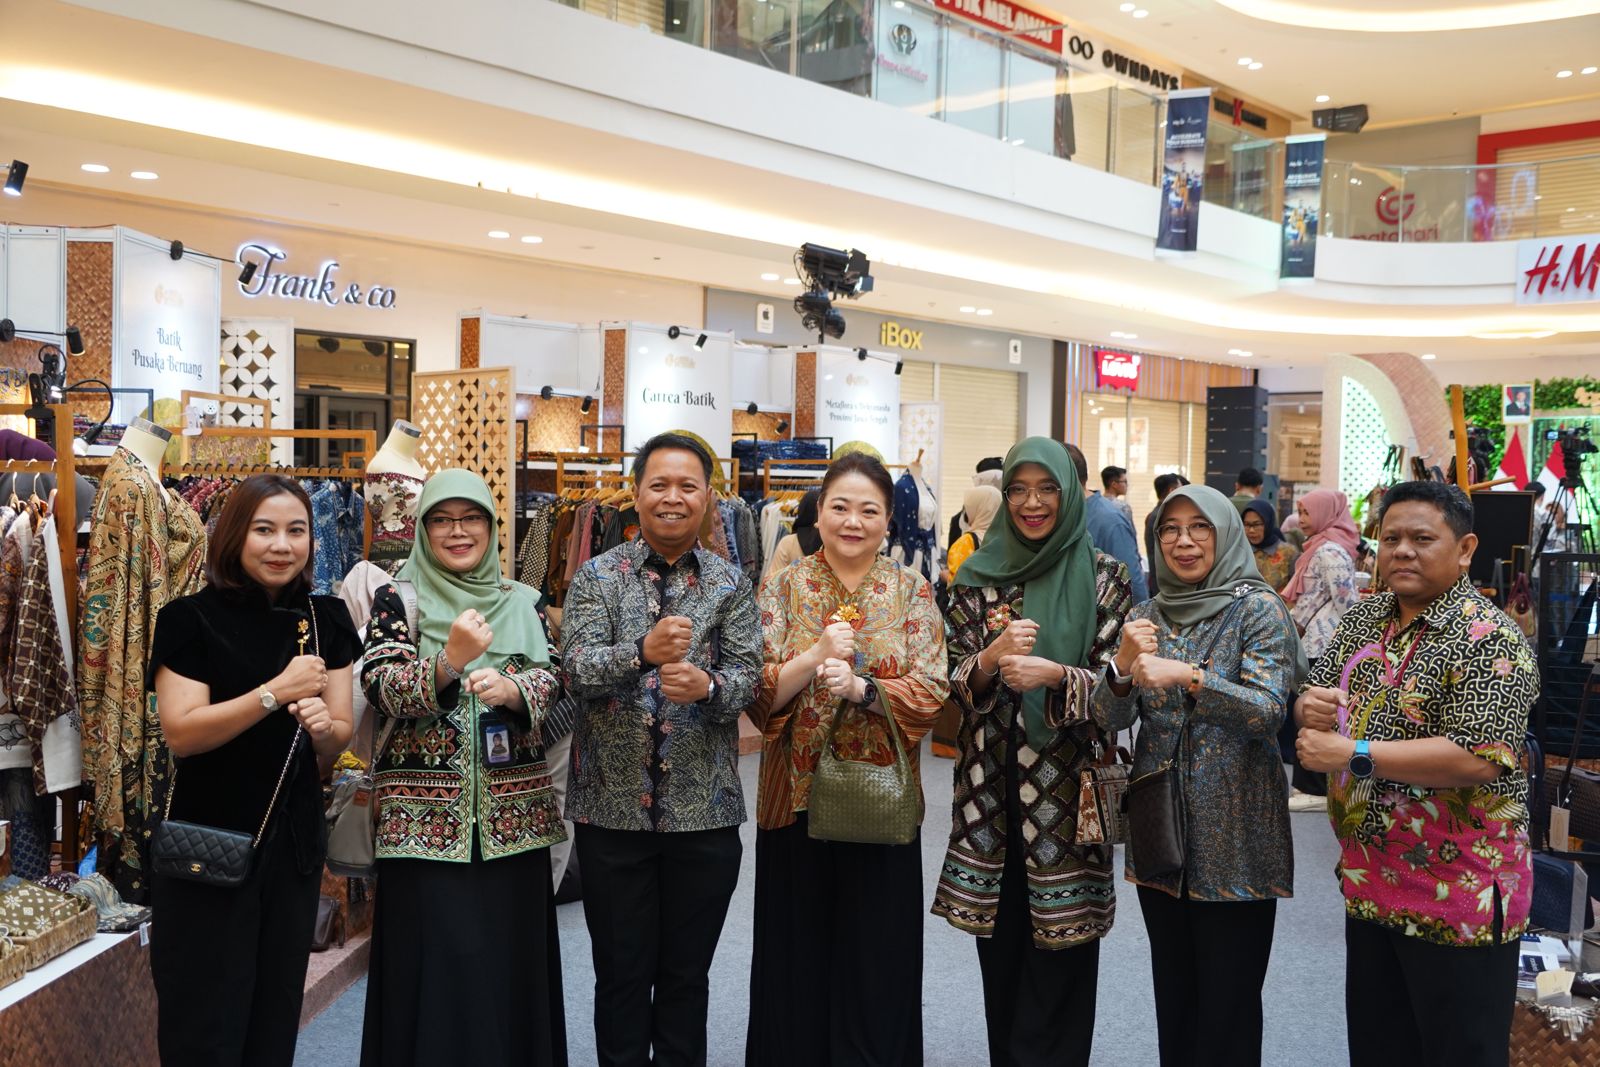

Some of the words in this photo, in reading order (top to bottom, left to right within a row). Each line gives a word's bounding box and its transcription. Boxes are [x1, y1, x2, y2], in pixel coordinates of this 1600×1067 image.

[1102, 49, 1179, 90] OWNDAYS
[238, 244, 340, 305] Frank
[344, 283, 363, 305] &
[1523, 242, 1600, 296] H&M
[157, 327, 183, 352] Batik
[880, 321, 924, 351] iBox
[132, 349, 165, 374] Pusaka
[683, 390, 717, 410] Batik
